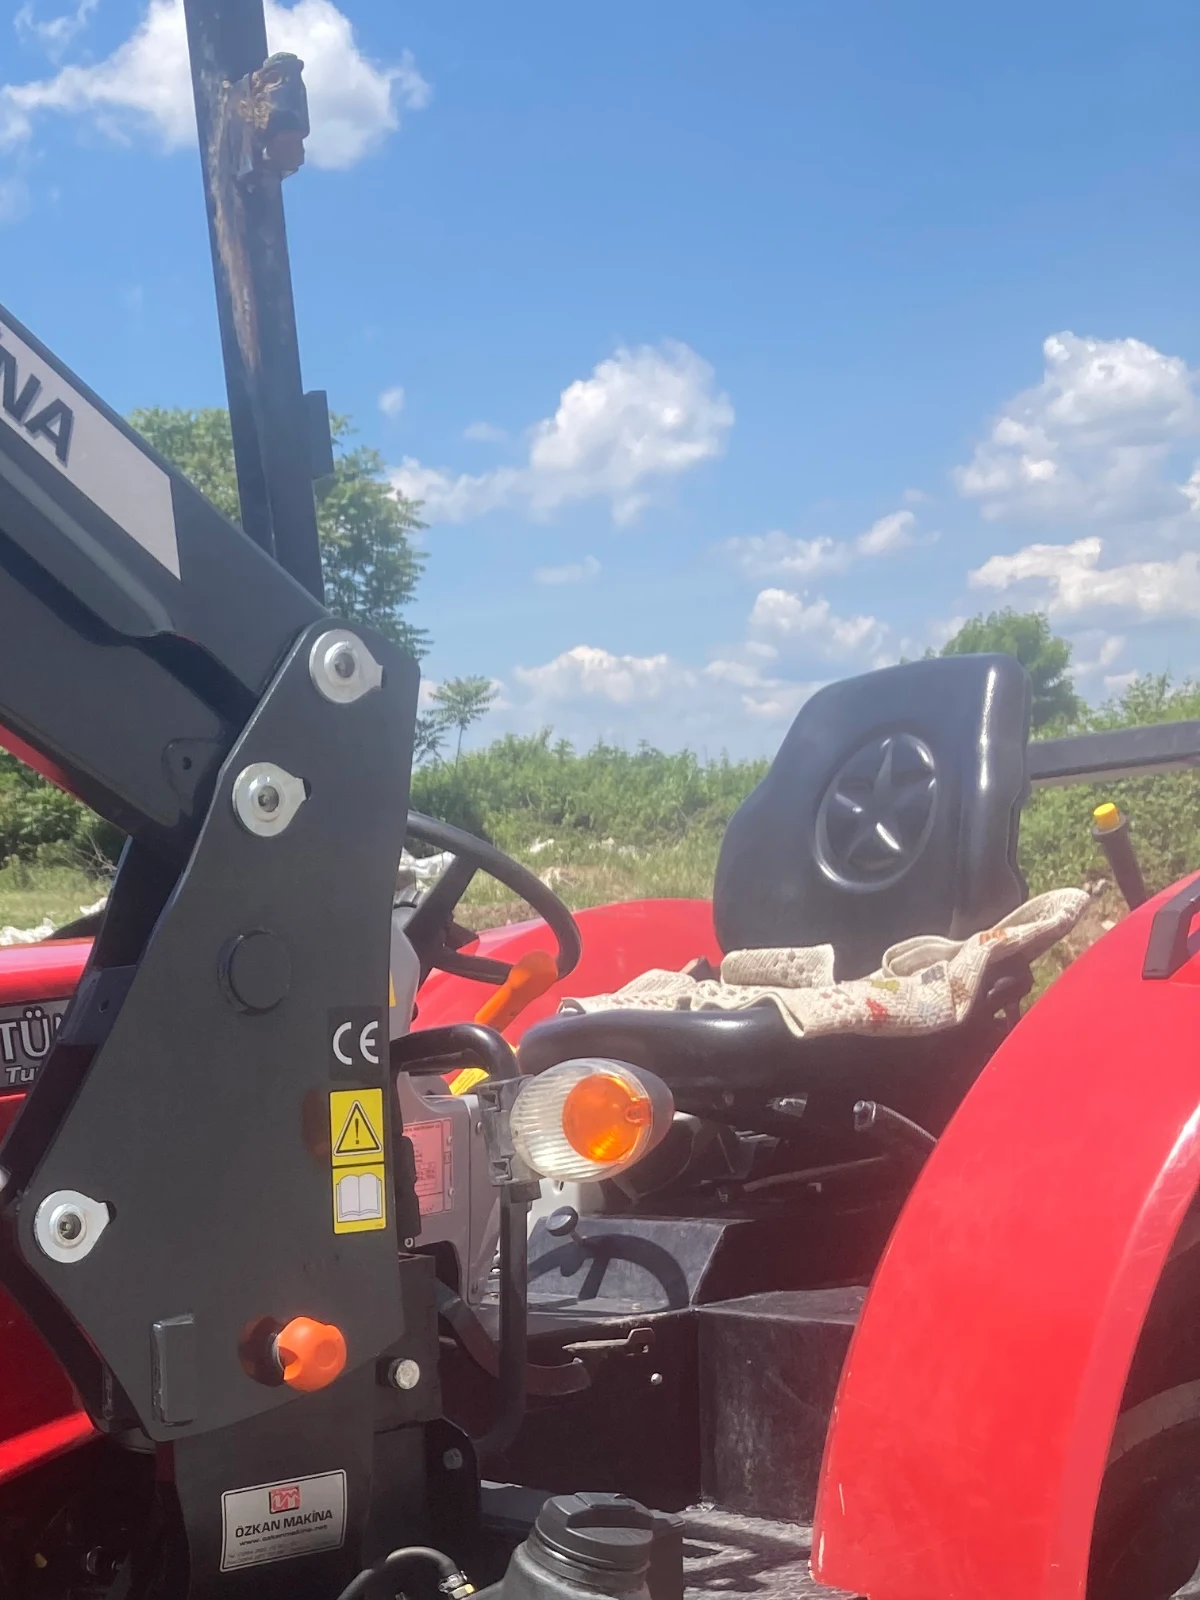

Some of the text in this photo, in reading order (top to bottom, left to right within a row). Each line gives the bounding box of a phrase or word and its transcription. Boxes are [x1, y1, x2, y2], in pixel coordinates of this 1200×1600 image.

[332, 1020, 380, 1066] CE
[235, 1510, 334, 1538] ÖZKAN MAKİNA
